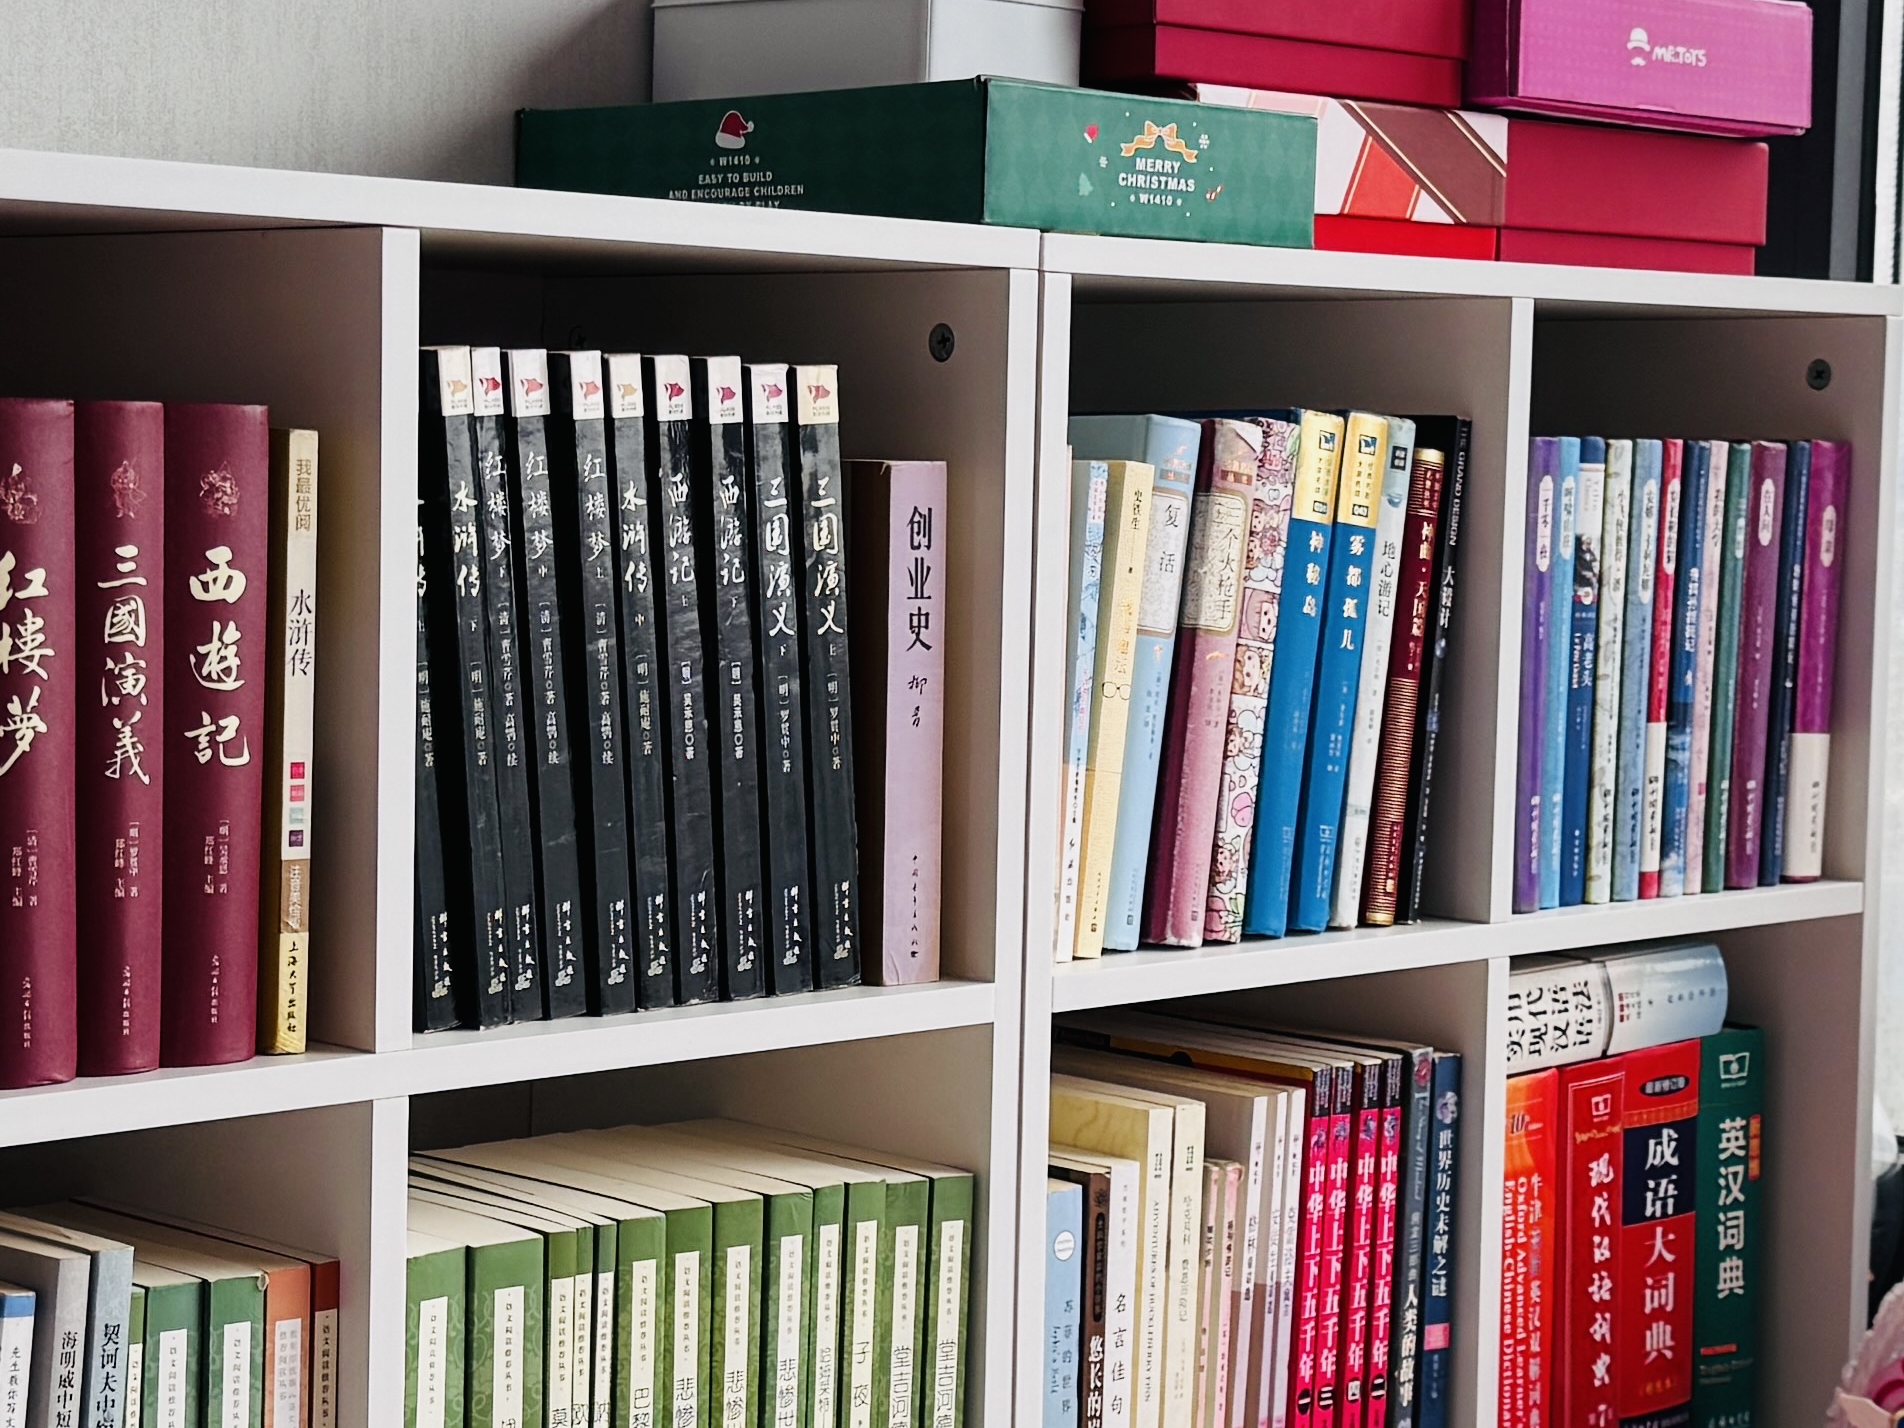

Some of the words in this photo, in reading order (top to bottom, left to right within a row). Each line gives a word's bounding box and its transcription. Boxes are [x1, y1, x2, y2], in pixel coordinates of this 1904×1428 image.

[669, 190, 687, 199] AND
[691, 187, 750, 199] ENCOURAGE
[754, 184, 803, 196] CHILDREN
[699, 174, 723, 184] EASY
[728, 173, 739, 183] TO
[743, 172, 772, 182] BUILD
[720, 155, 750, 166] W1410
[1118, 173, 1195, 192] CHRISTMAS
[1136, 157, 1180, 173] MERRY
[1139, 194, 1173, 206] W1410
[1453, 452, 1466, 497] GRAND
[762, 477, 795, 638] 三国演义
[810, 477, 844, 636] 三国演义
[1159, 504, 1181, 573] 复活
[1448, 499, 1463, 546] DESIGN
[906, 505, 933, 654] 创业史
[1339, 535, 1366, 652] 雾都孤儿
[1375, 540, 1397, 618] 地心游记
[1438, 565, 1455, 629] 大设计
[287, 588, 314, 677] 水浒传
[1431, 1129, 1454, 1297] 世界历史未解之谜
[1516, 1177, 1528, 1244] Oxford
[1644, 1127, 1680, 1367] 成语大词典
[1716, 1116, 1748, 1300] 英汉词典
[1298, 1159, 1326, 1384] 中华上下五千年
[1319, 1156, 1349, 1379] 中华上下五千年
[1347, 1151, 1376, 1373] 中华上下五千年
[1370, 1149, 1399, 1370] 中华上下五千年
[1516, 1248, 1527, 1340] Advanced
[853, 1341, 870, 1408] 子夜
[1111, 1293, 1126, 1415] 名言佳句
